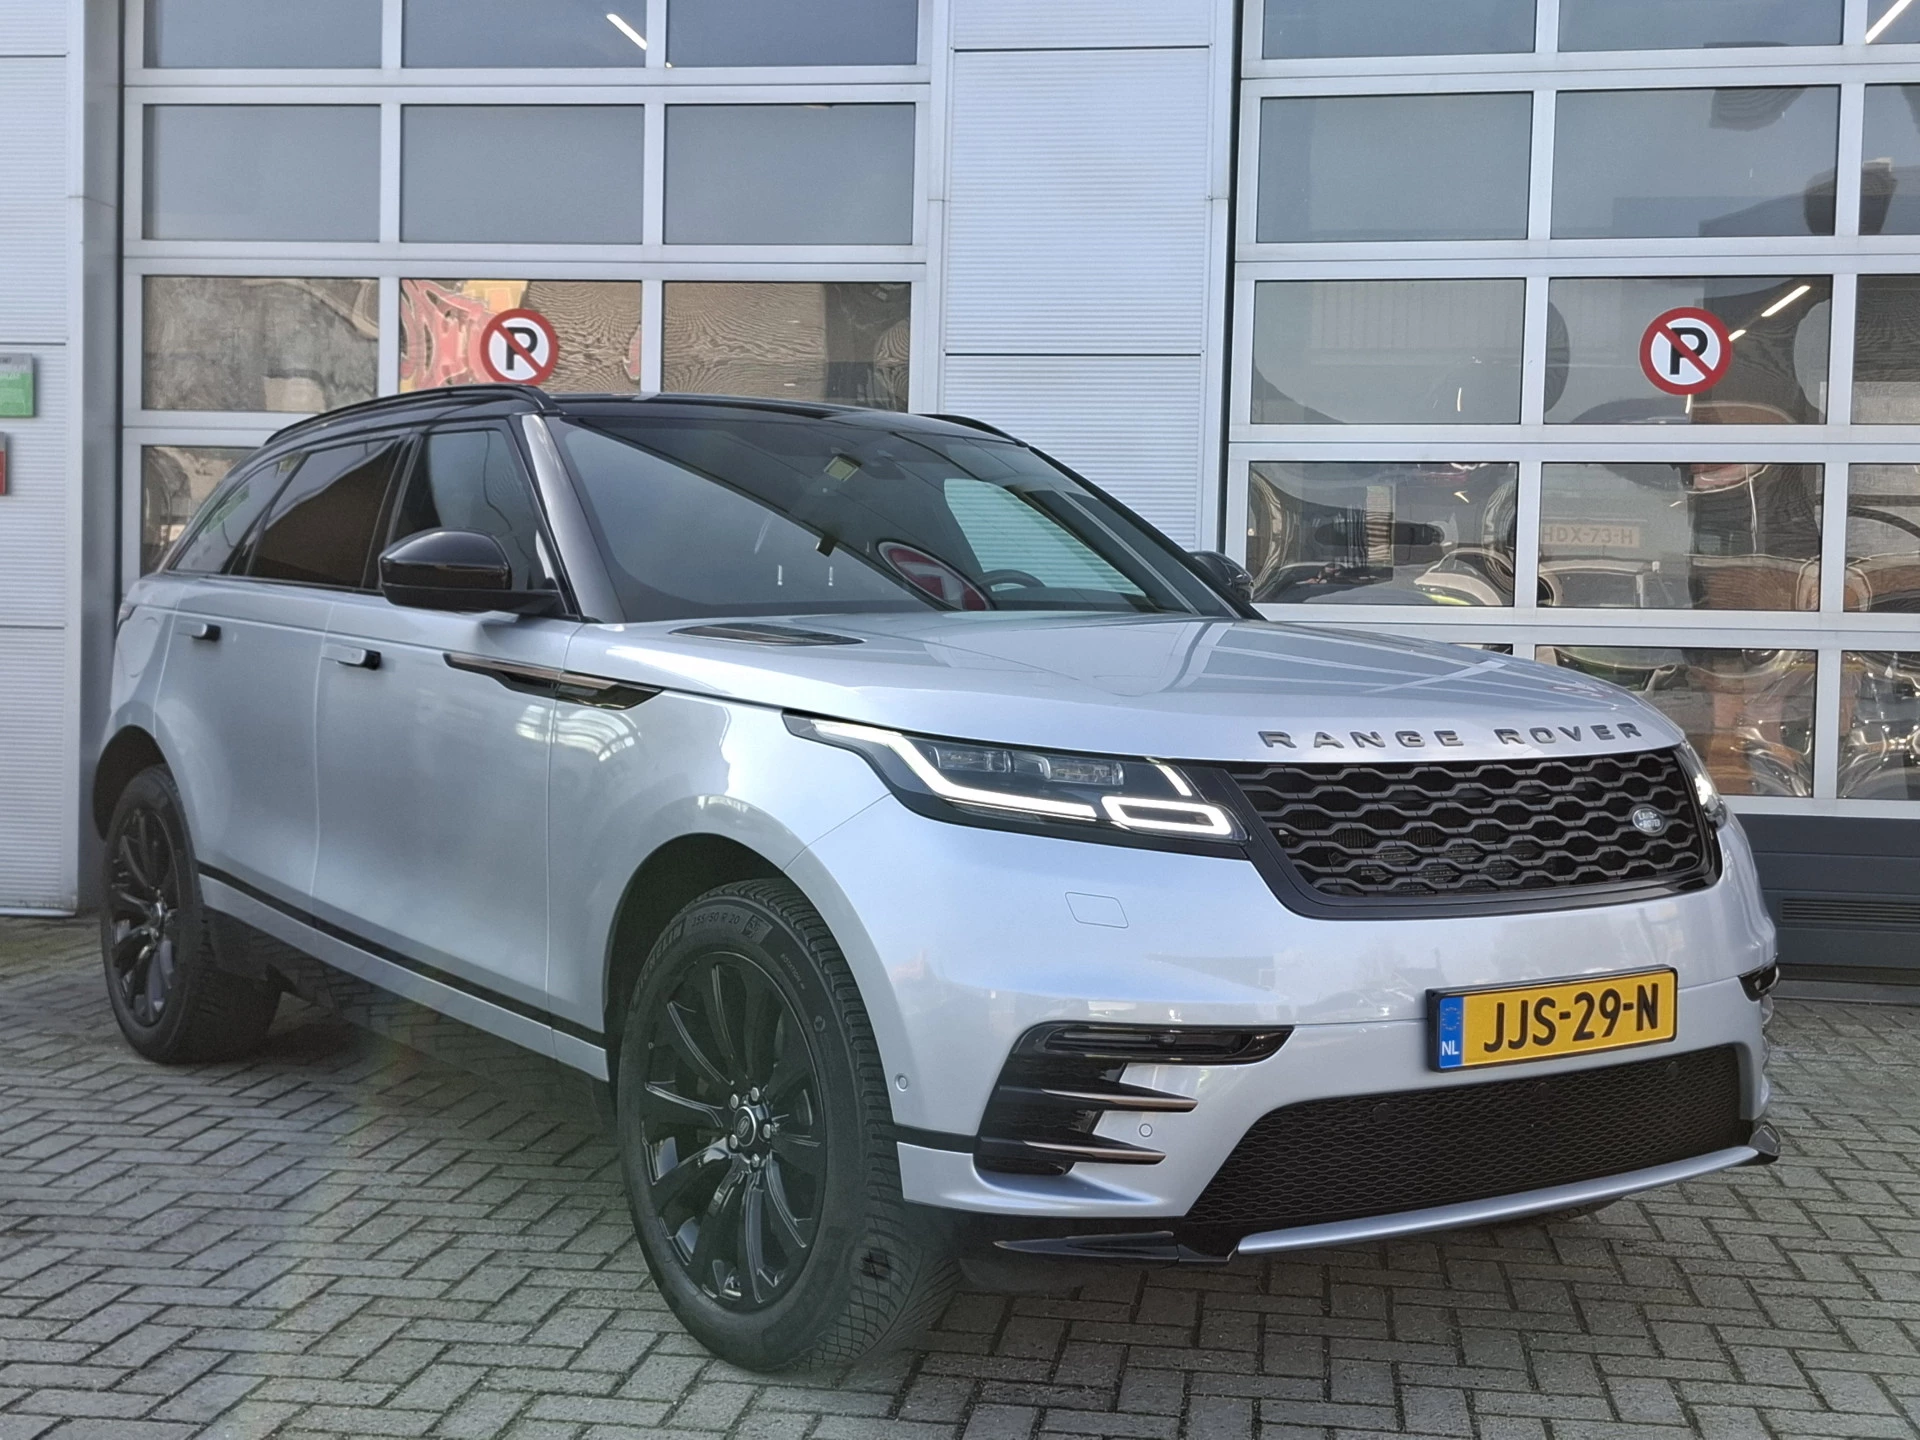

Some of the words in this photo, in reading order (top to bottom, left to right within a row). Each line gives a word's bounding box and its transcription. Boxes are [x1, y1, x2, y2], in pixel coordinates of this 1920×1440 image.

[506, 327, 538, 371] P
[1669, 327, 1708, 375] P
[1258, 730, 1465, 749] RANGE
[1493, 722, 1642, 745] ROVER
[1484, 983, 1659, 1053] JJS-29-N
[1441, 1040, 1460, 1057] NL
